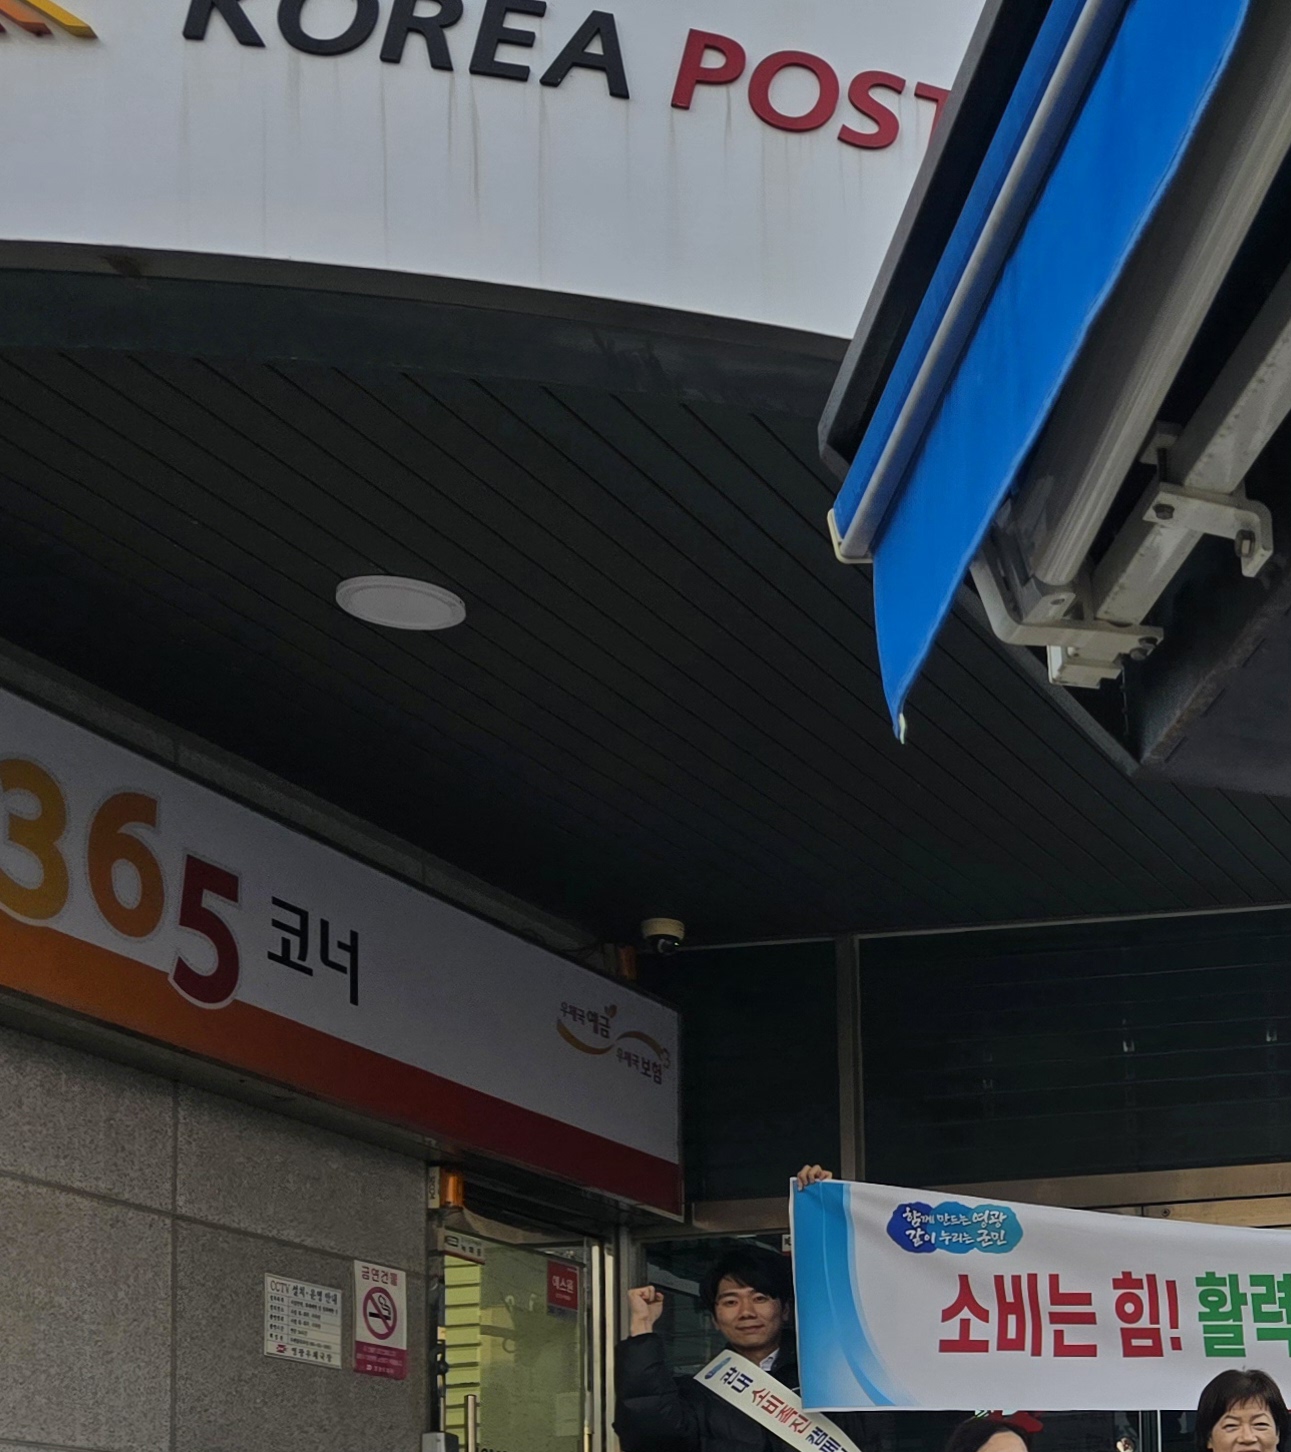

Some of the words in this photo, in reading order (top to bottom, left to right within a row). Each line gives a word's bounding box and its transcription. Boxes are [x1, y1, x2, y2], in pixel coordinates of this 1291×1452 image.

[0, 759, 239, 1005] 365
[268, 897, 359, 1006] 코너
[903, 1207, 935, 1226] 함께
[936, 1213, 972, 1226] 만드는
[972, 1210, 1007, 1228] 영광
[905, 1227, 936, 1247] 같이
[939, 1230, 975, 1245] 누리는
[976, 1229, 1007, 1246] 군민
[938, 1273, 1097, 1358] 소비는
[1112, 1271, 1183, 1358] 힘!
[719, 1366, 753, 1394] 관내
[750, 1387, 813, 1434] 소비촉진
